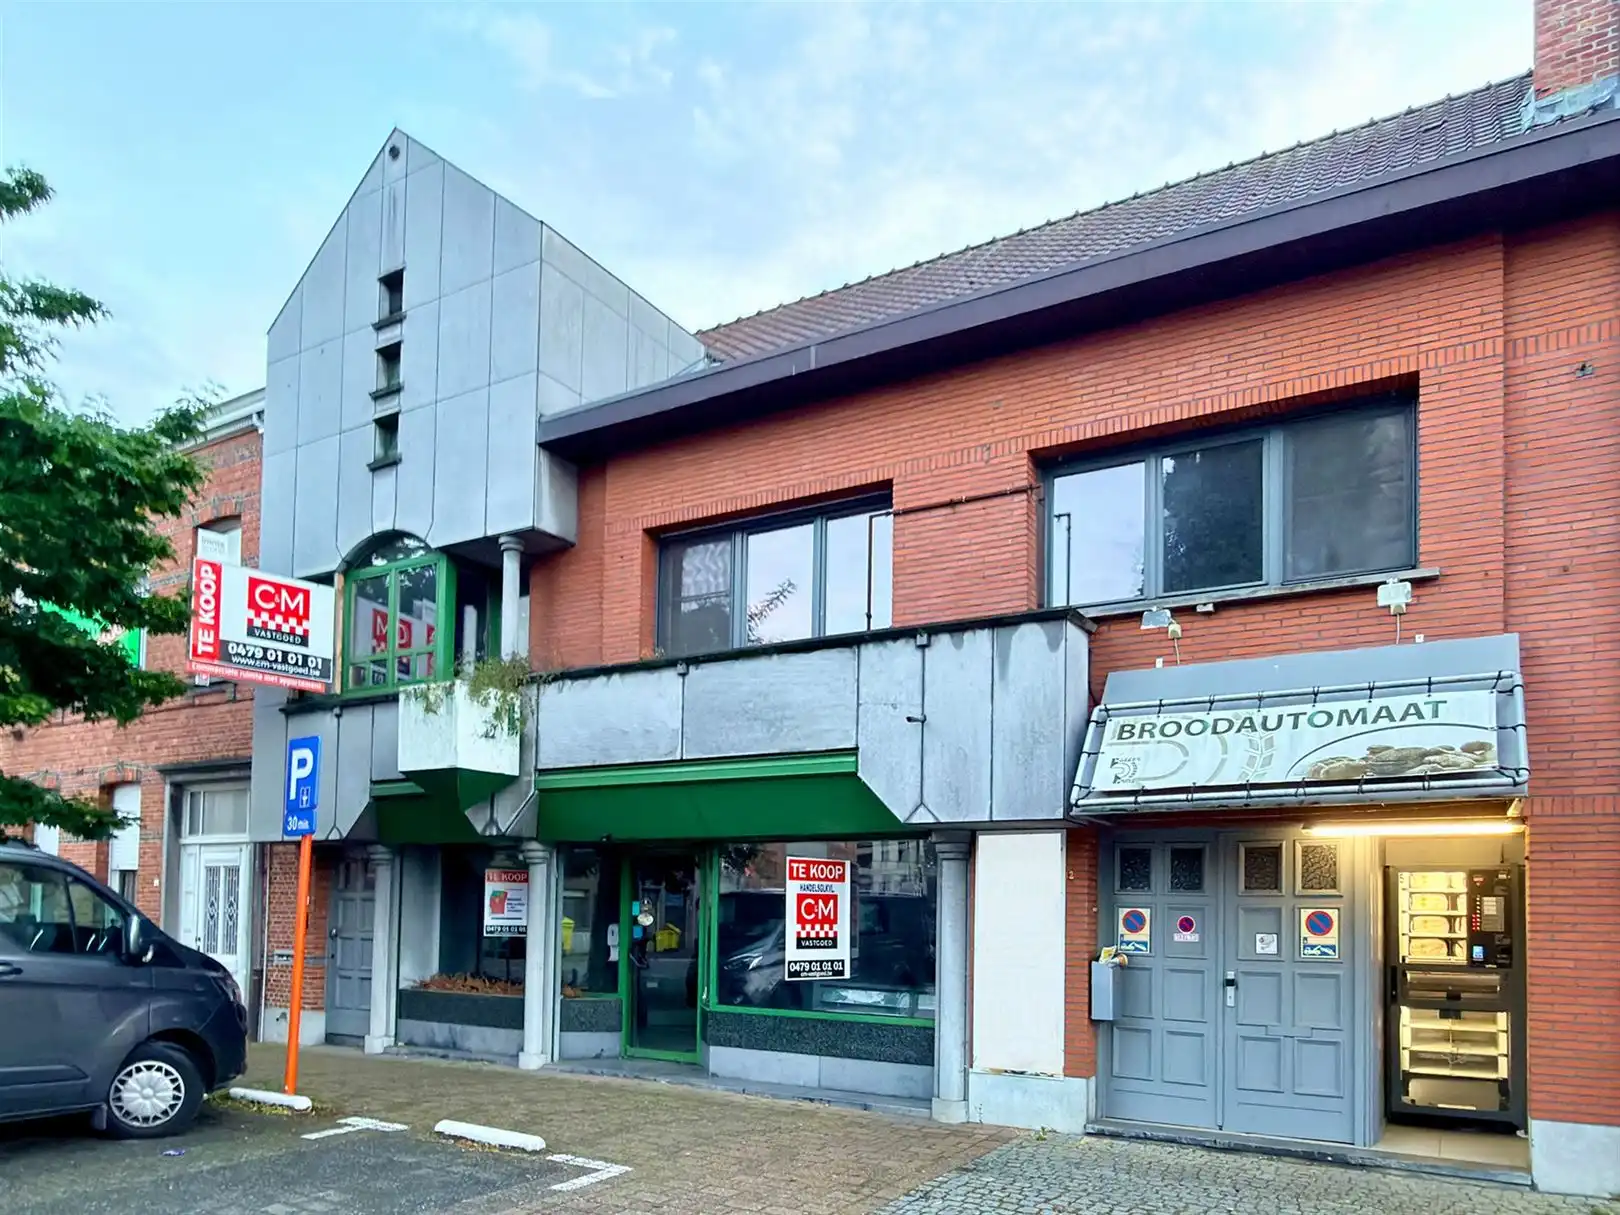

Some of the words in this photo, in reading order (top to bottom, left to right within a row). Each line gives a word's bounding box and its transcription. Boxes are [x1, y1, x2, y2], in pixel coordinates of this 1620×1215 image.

[199, 565, 217, 626] KOOP
[197, 628, 214, 655] TE
[254, 628, 302, 645] VASTGOED
[228, 642, 264, 659] 0479
[267, 649, 282, 663] 01
[287, 653, 303, 667] 01
[307, 656, 323, 670] 01
[1117, 699, 1448, 741] BROODAUTOMAAT
[289, 748, 314, 801] P
[287, 815, 298, 831] 30
[502, 872, 527, 881] KOOP
[791, 863, 807, 878] TE
[809, 864, 844, 880] KOOP
[790, 961, 810, 972] 0479
[811, 961, 821, 971] 01
[822, 961, 832, 971] 01
[833, 961, 843, 971] 01
